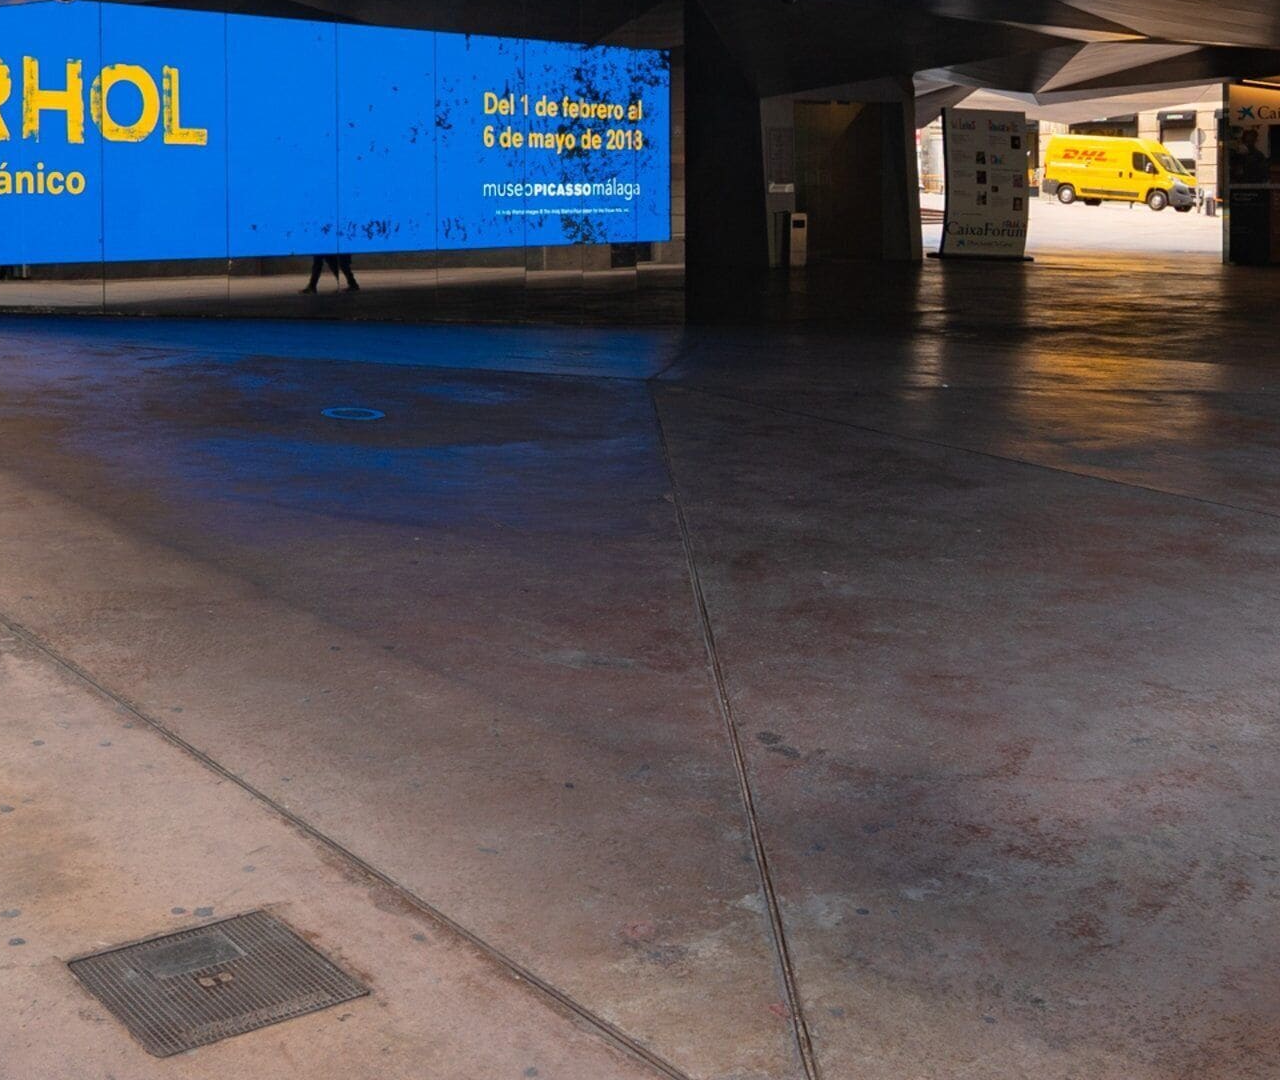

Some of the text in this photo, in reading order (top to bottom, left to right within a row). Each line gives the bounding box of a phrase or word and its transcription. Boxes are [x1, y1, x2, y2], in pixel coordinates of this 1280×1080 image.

[483, 92, 643, 121] Del 1 de febrero al
[483, 125, 495, 149] 6
[499, 126, 524, 149] de
[528, 129, 576, 154] mayo
[581, 128, 602, 150] de
[1062, 148, 1109, 162] DHL
